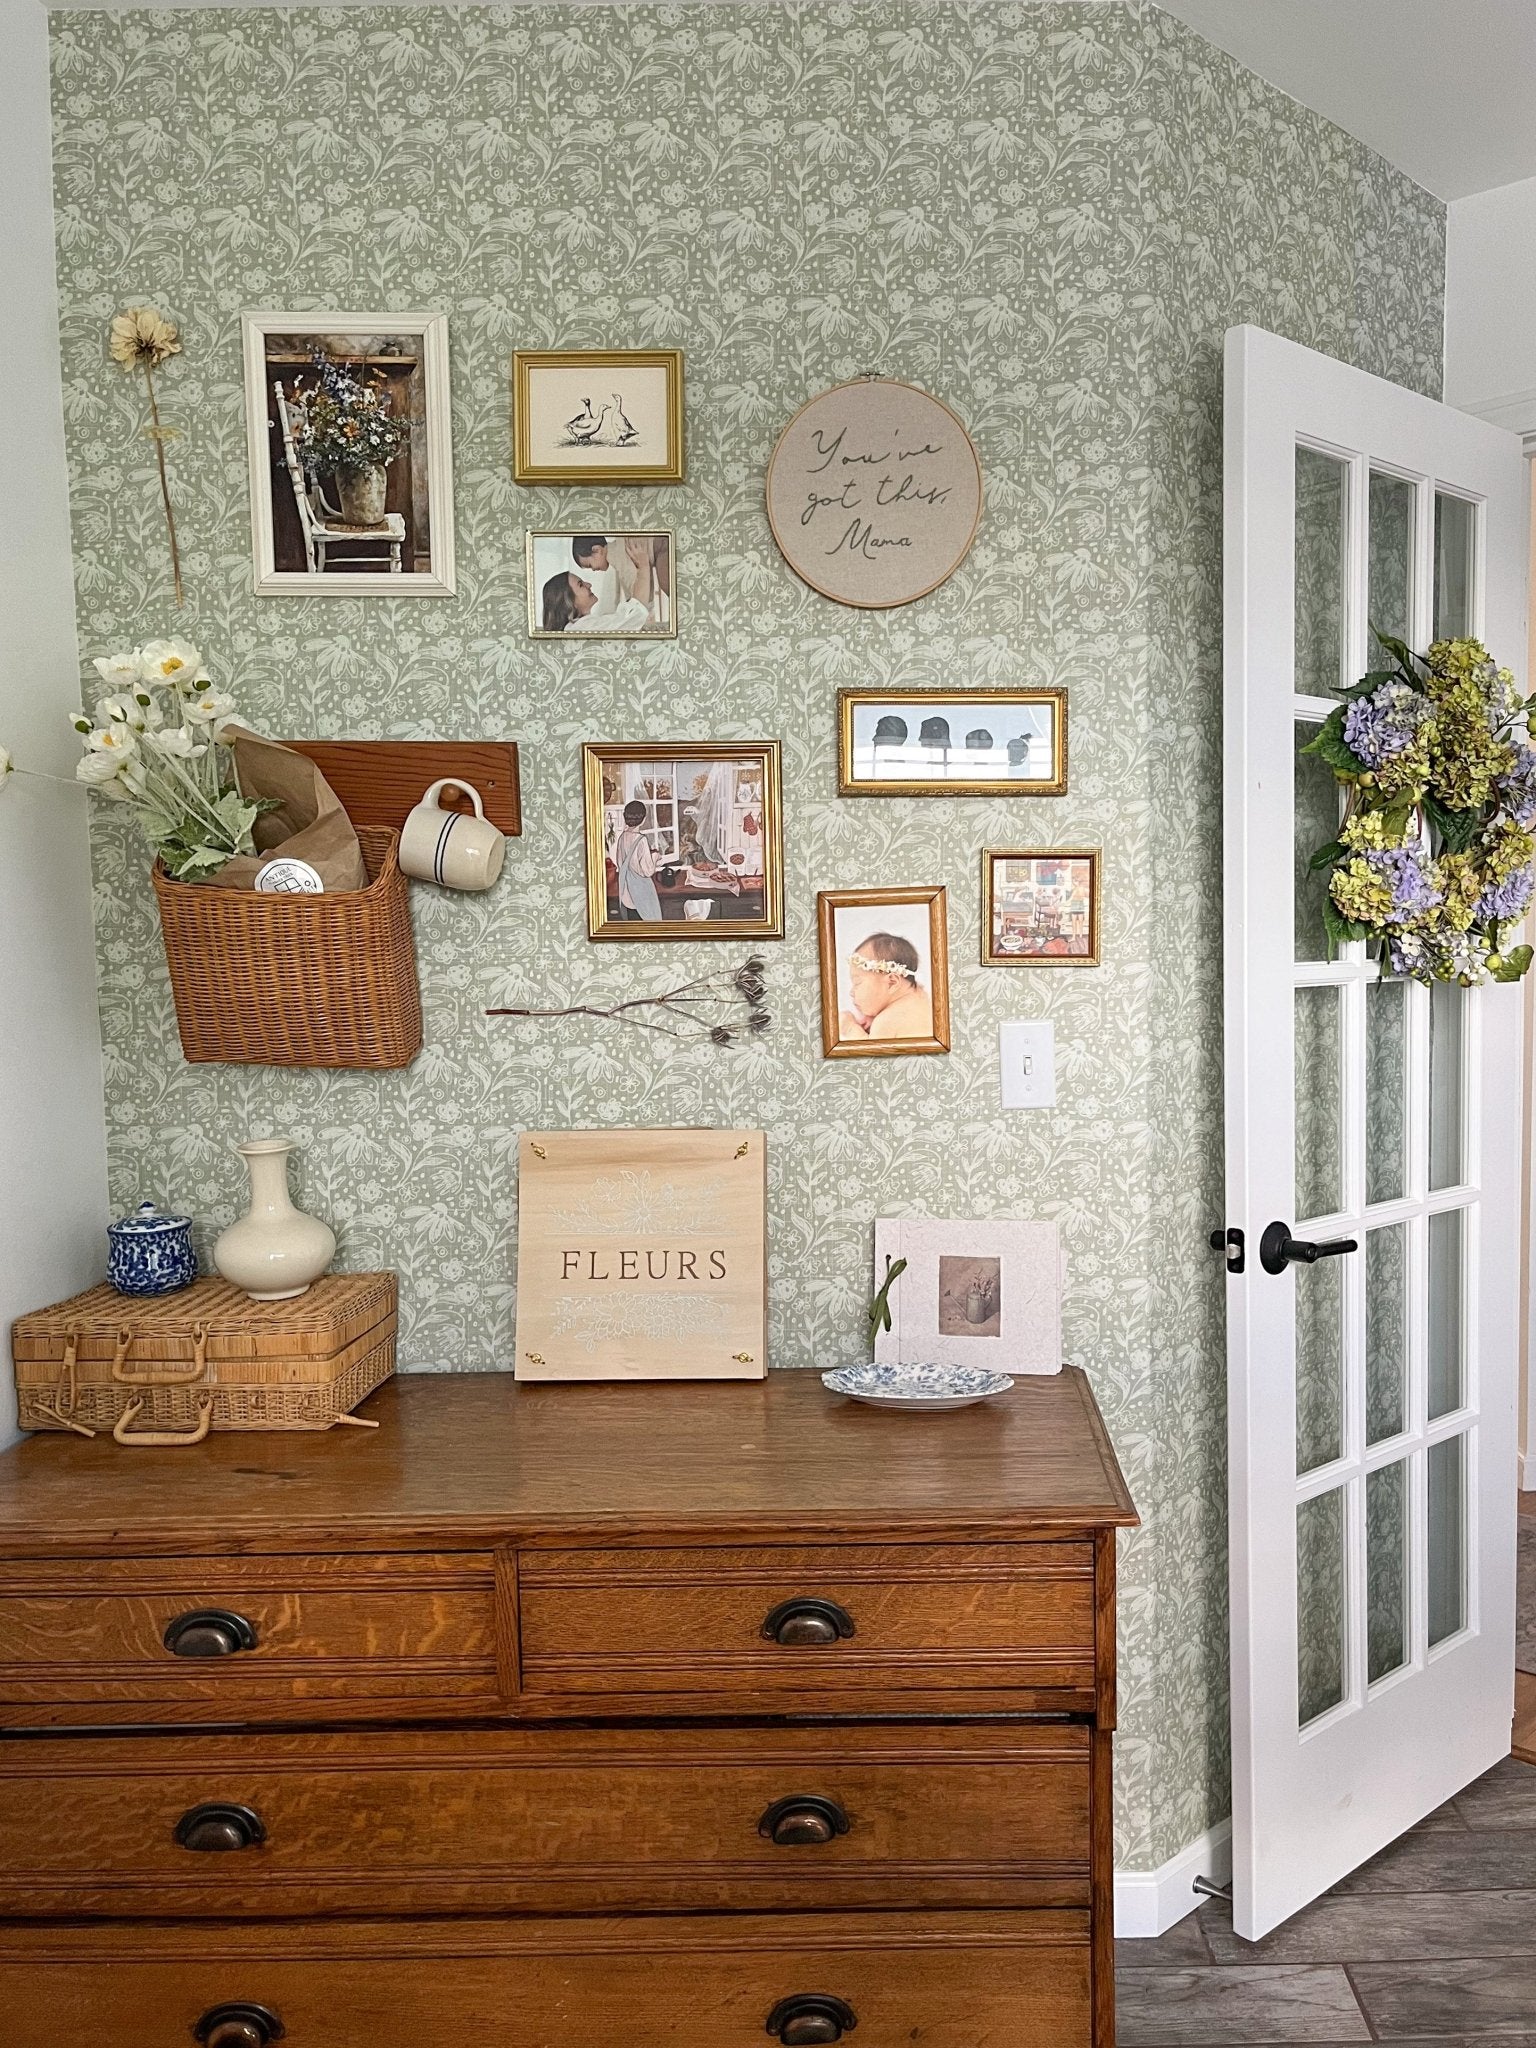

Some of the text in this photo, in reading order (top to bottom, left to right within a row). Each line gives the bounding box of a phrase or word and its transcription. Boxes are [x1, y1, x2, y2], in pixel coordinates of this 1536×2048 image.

[806, 427, 943, 473] You've
[801, 478, 862, 526] got
[825, 517, 912, 560] Mama
[560, 1250, 726, 1280] FLEURS
